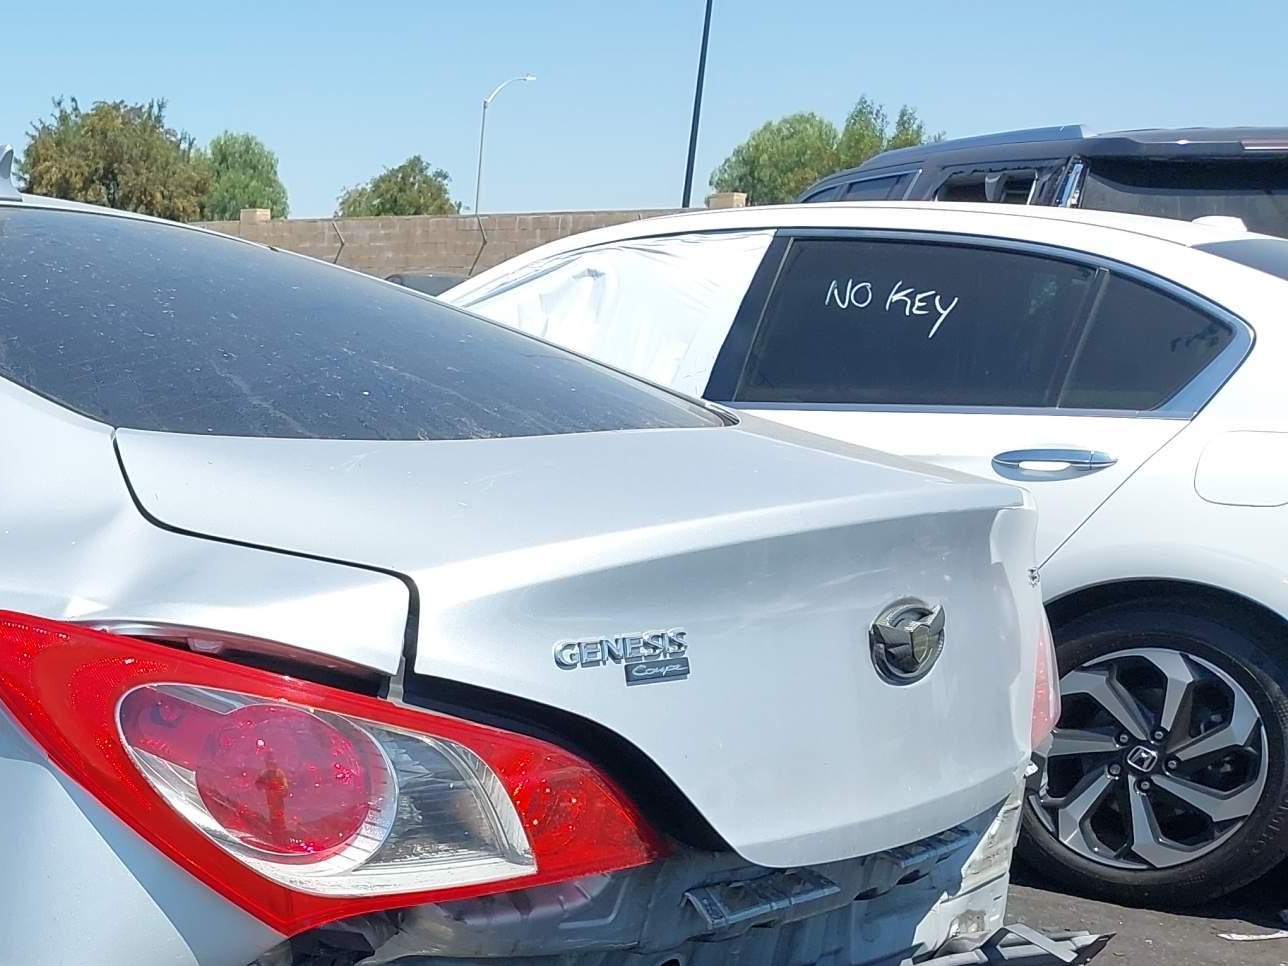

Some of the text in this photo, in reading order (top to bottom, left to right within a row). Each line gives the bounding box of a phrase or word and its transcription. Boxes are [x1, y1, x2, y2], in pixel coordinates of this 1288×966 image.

[825, 278, 959, 339] NO KEY
[553, 628, 688, 670] GENESIS
[631, 663, 689, 677] Coupe
